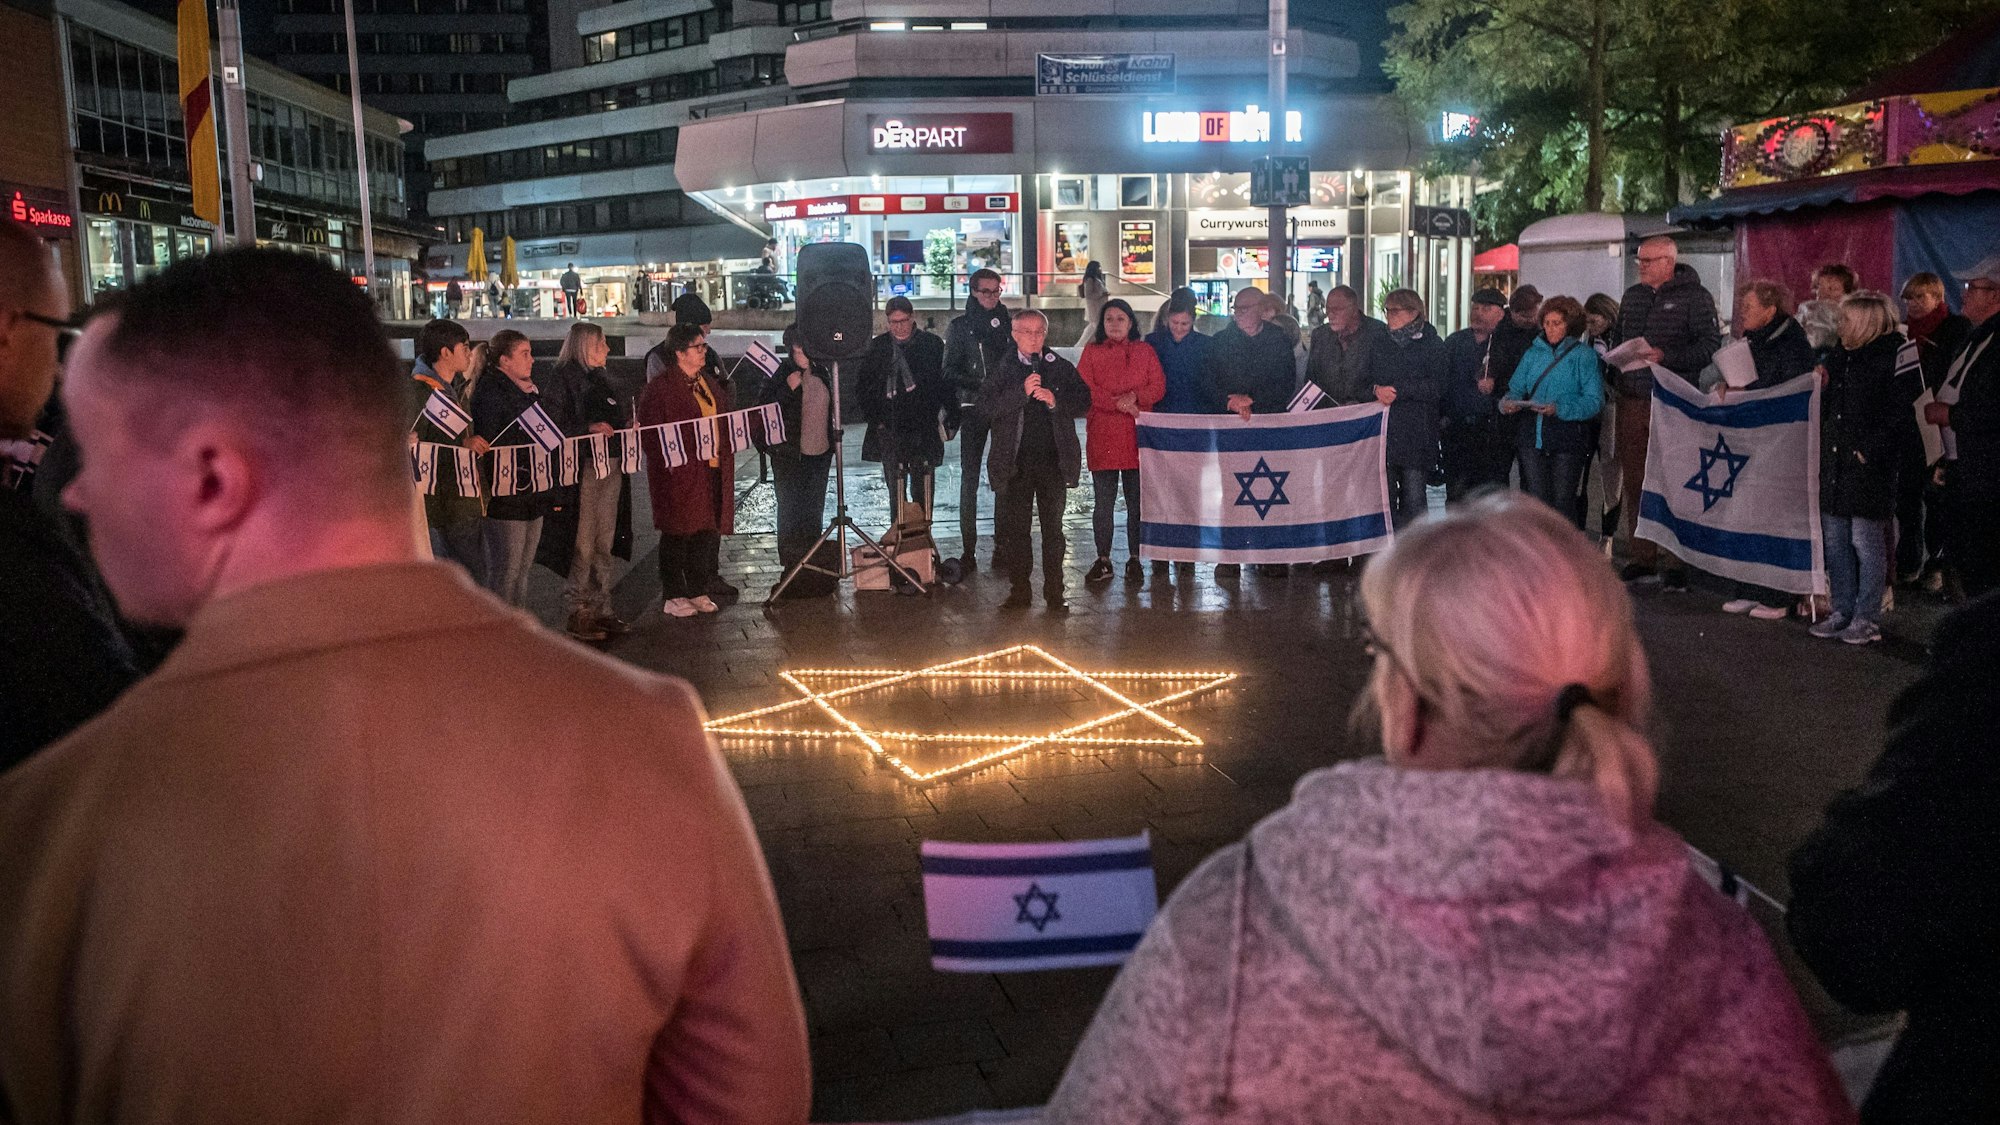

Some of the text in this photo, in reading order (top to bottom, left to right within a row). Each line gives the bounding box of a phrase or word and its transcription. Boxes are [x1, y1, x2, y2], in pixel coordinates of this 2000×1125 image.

[1065, 71, 1161, 83] Schlüsseldienst
[1206, 118, 1224, 136] OF
[29, 207, 71, 227] Sparkasse
[1200, 218, 1268, 231] Currywurst
